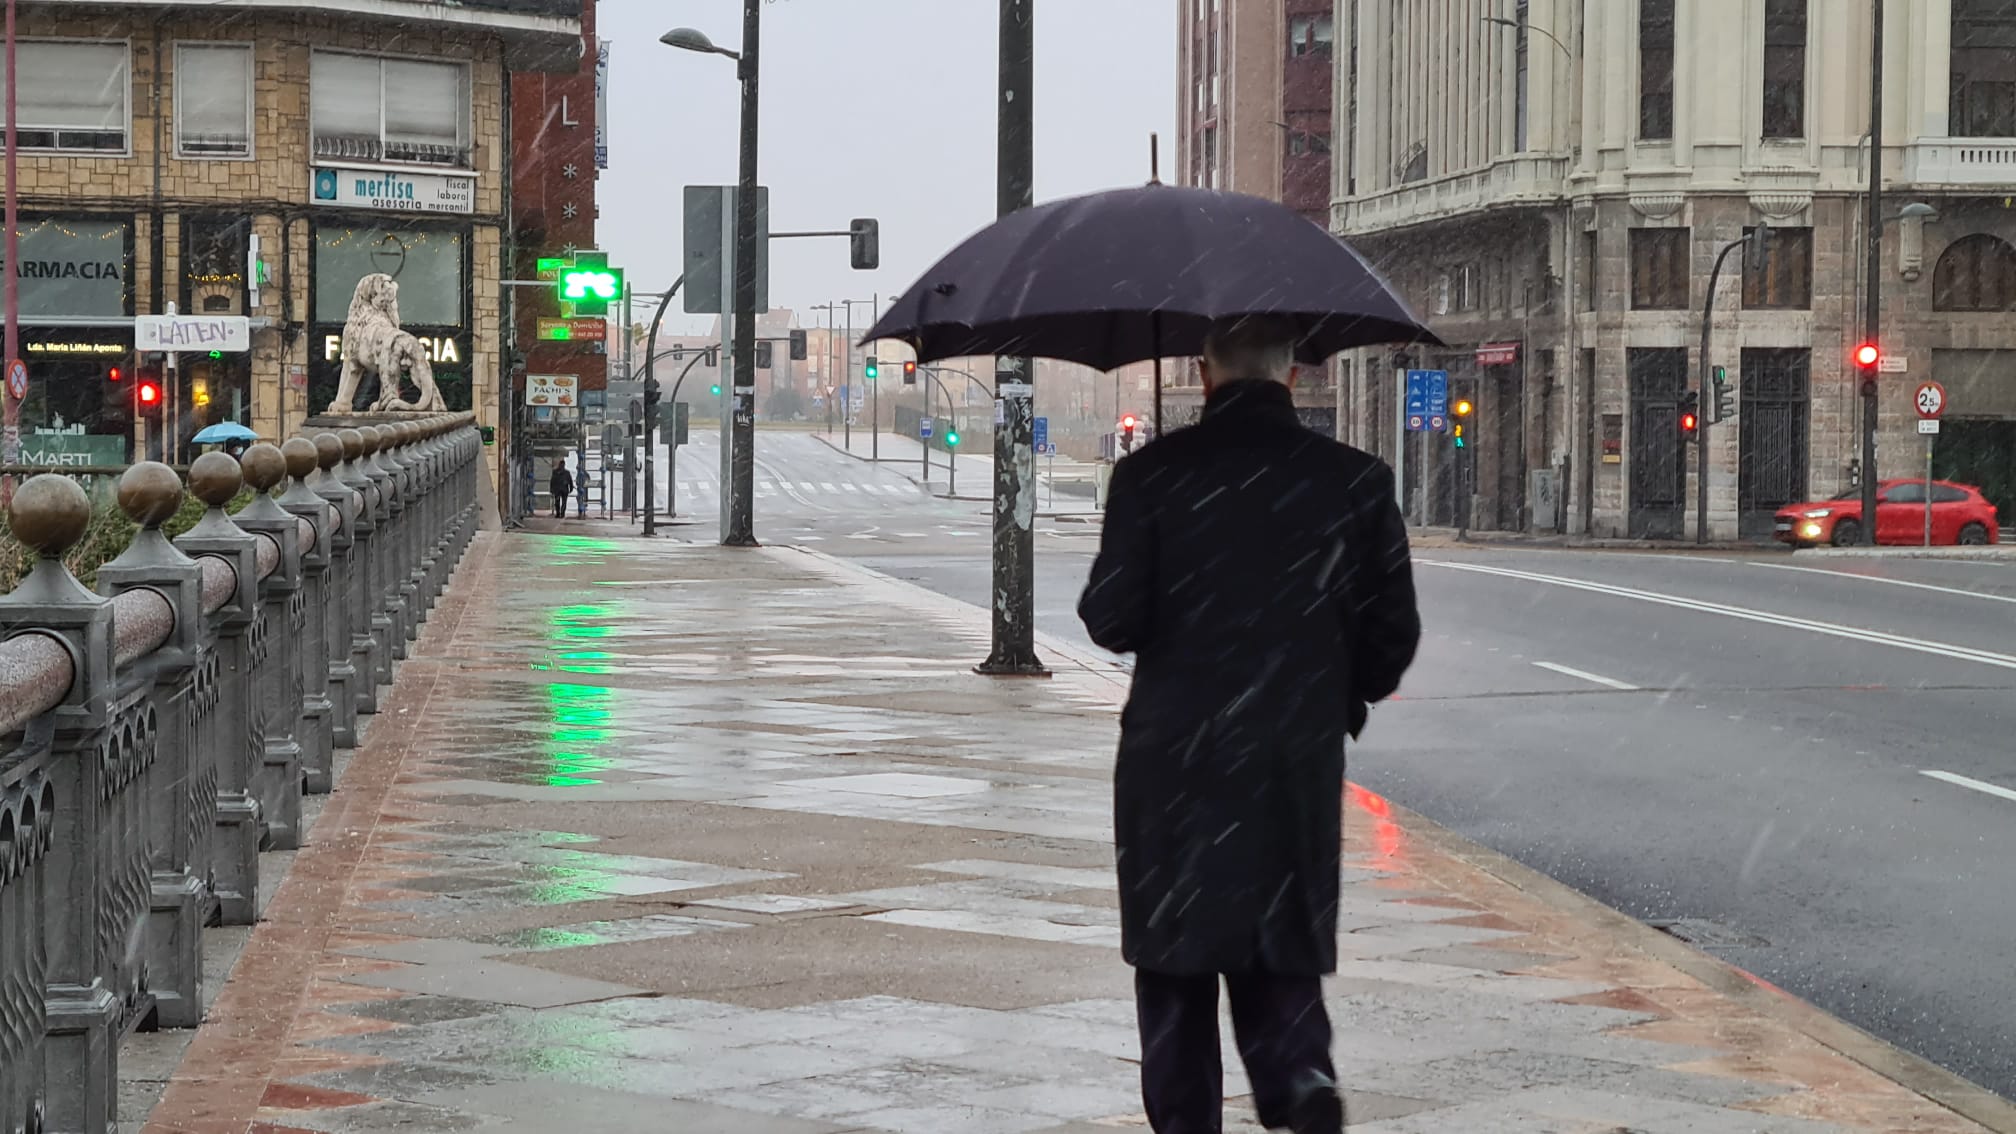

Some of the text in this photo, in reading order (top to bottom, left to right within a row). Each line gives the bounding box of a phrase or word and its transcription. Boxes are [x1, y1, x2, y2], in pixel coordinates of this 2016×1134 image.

[355, 174, 415, 199] merfisa
[446, 178, 470, 189] fiscal
[437, 189, 470, 201] laboral
[428, 201, 470, 212] mercantil
[325, 335, 459, 362] FCIA
